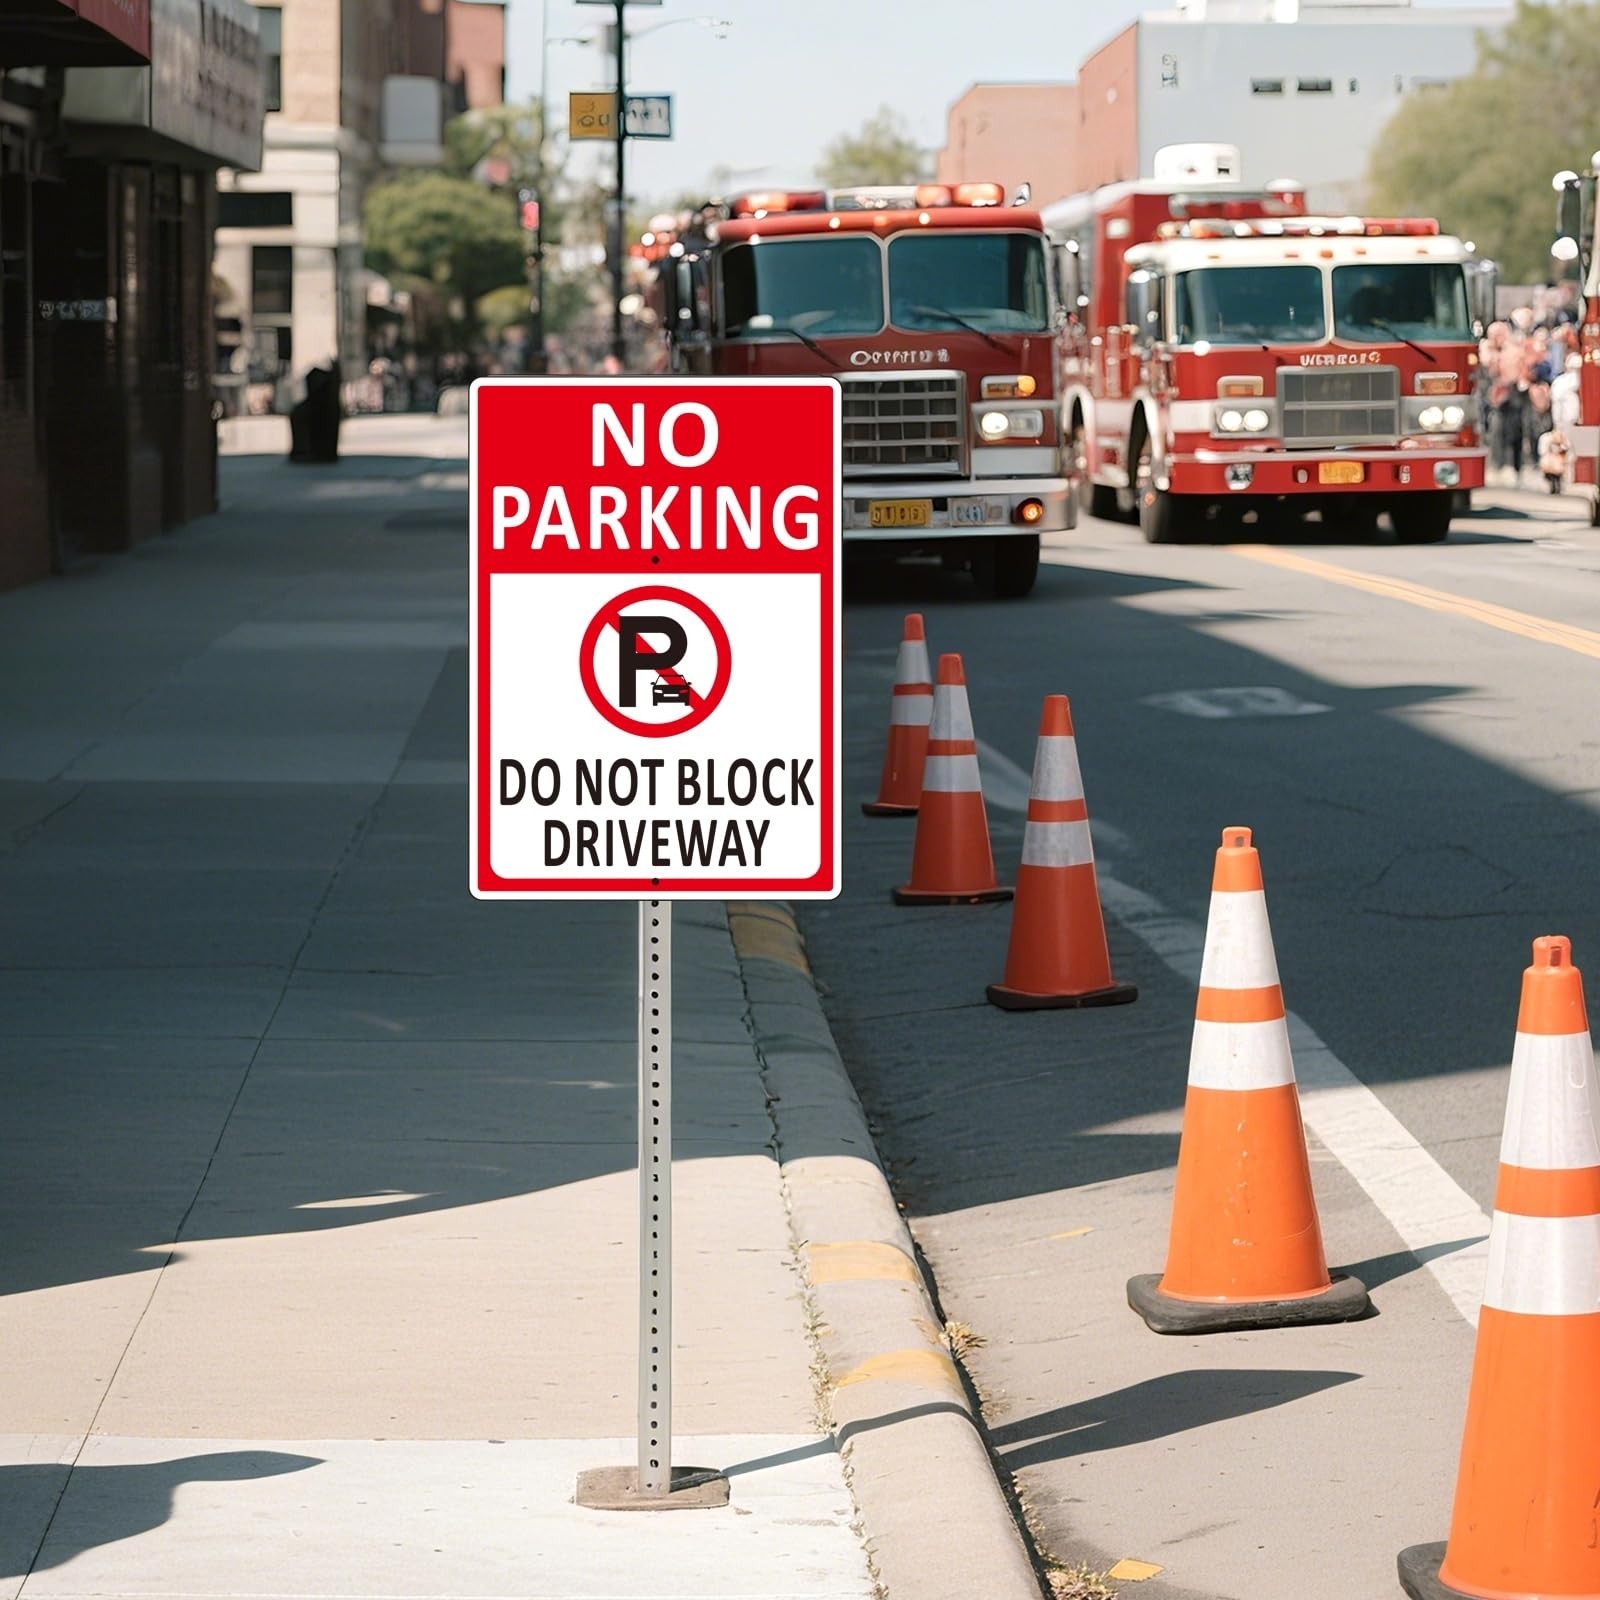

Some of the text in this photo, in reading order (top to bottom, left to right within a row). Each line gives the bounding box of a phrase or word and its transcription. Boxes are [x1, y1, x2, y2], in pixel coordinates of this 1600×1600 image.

[592, 402, 719, 468] NO
[492, 485, 820, 551] PARKING
[500, 758, 815, 807] DO NOT BLOCK
[544, 819, 771, 867] DRIVEWAY
